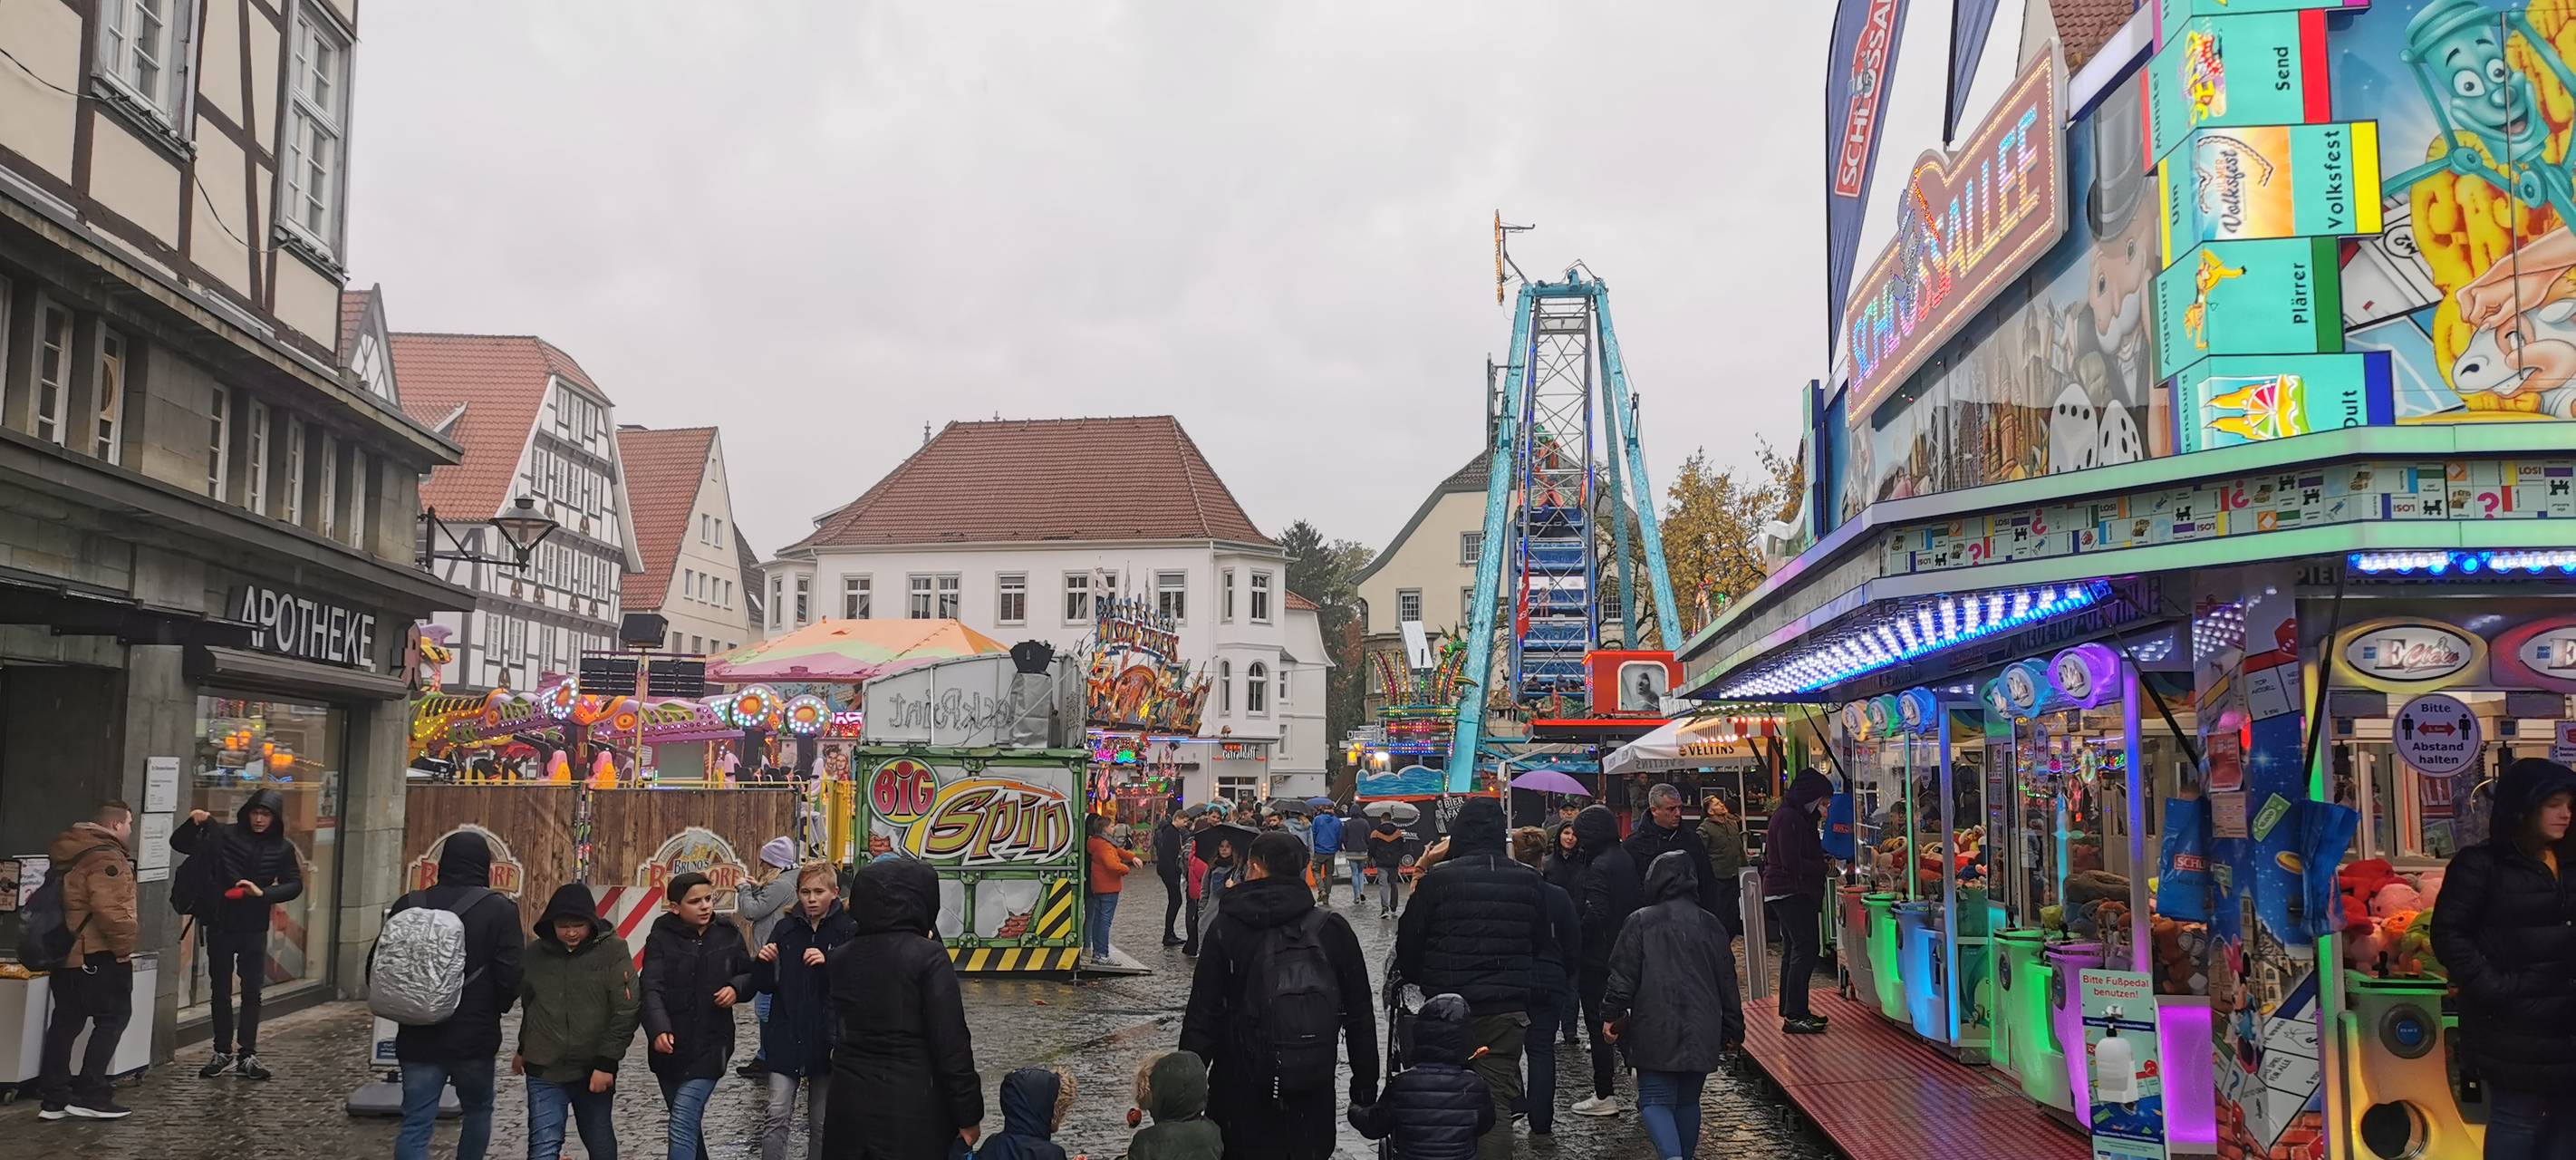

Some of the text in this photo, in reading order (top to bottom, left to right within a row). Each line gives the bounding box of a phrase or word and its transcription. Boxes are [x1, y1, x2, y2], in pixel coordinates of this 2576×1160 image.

[2272, 46, 2291, 92] Send
[1841, 0, 1891, 187] SCHLOSSA
[2220, 149, 2245, 234] Volksfest
[2323, 130, 2344, 229] Volksfest
[2172, 184, 2180, 227] Ulm
[2291, 263, 2309, 324] Plärrer
[2160, 280, 2171, 366] Augsburg
[2421, 703, 2451, 713] Bitte
[1689, 744, 1734, 756] VELTINS
[2412, 741, 2465, 751] Abstand
[2419, 755, 2459, 765] halten
[1443, 797, 1464, 808] BIER
[925, 788, 1070, 861] Spin
[2083, 974, 2149, 988] Bitte Fußpedal
[2093, 988, 2138, 999] benutzen!
